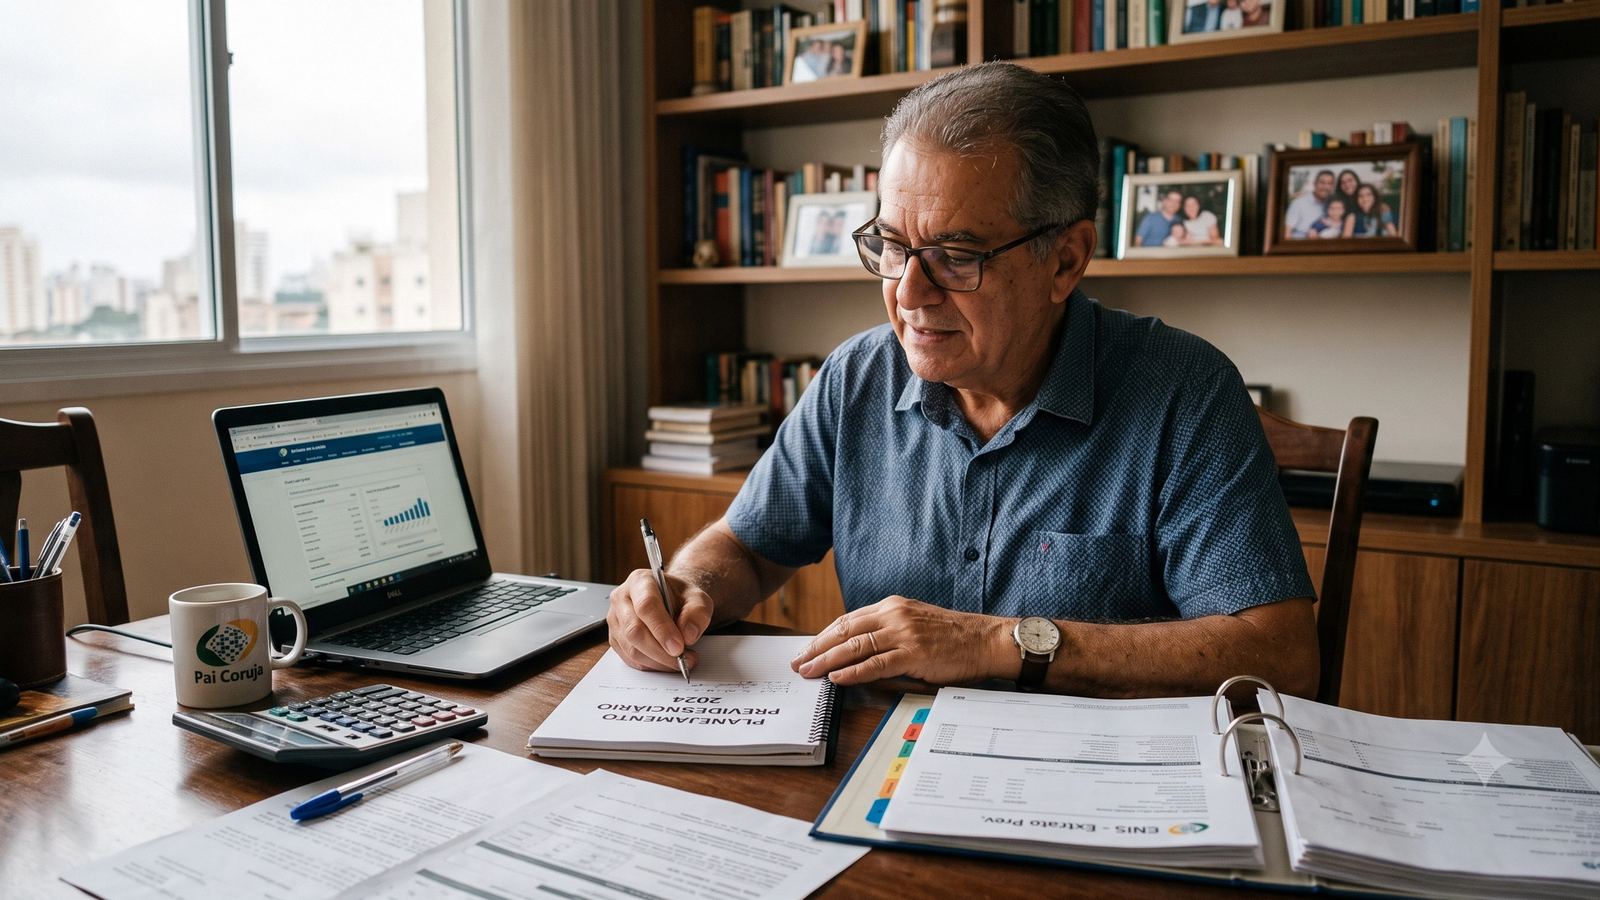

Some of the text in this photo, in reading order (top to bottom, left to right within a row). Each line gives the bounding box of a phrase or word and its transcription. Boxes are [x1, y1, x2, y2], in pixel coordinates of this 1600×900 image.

[194, 663, 264, 684] Pai Coruja
[672, 696, 723, 704] 2024
[602, 713, 766, 726] PLANEJAMENTO
[981, 815, 1024, 826] Prev.
[1030, 820, 1096, 832] Extrato
[1115, 825, 1159, 834] ENIS
